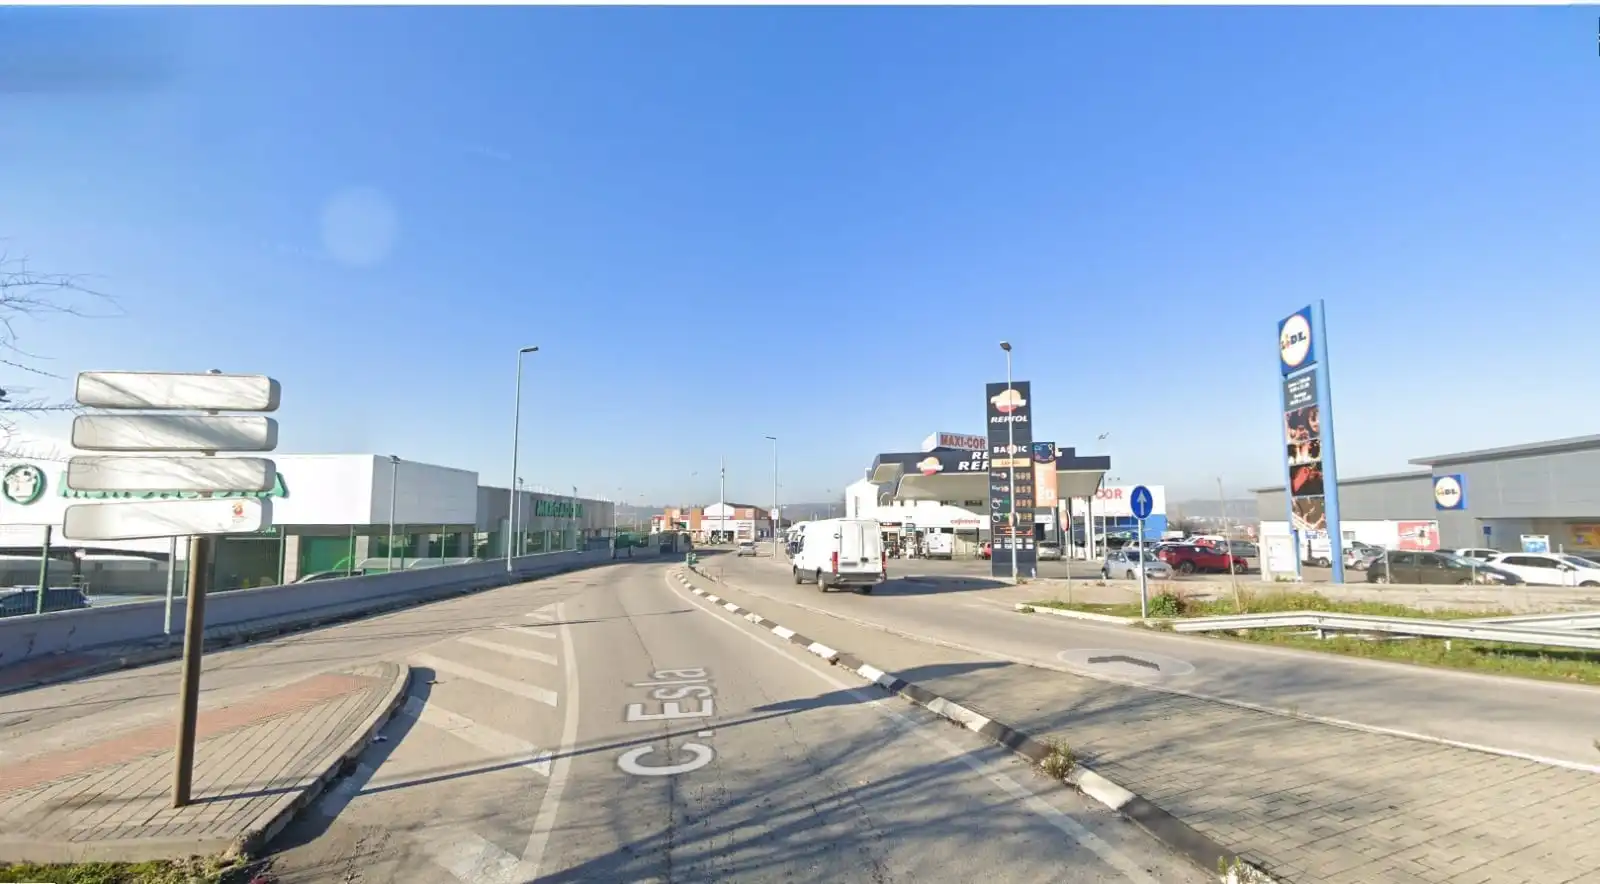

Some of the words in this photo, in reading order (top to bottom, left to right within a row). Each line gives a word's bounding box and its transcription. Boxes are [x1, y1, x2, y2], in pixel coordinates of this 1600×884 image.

[940, 434, 986, 449] MAXI-COR
[993, 445, 1028, 455] BAIC
[626, 668, 713, 722] Esla
